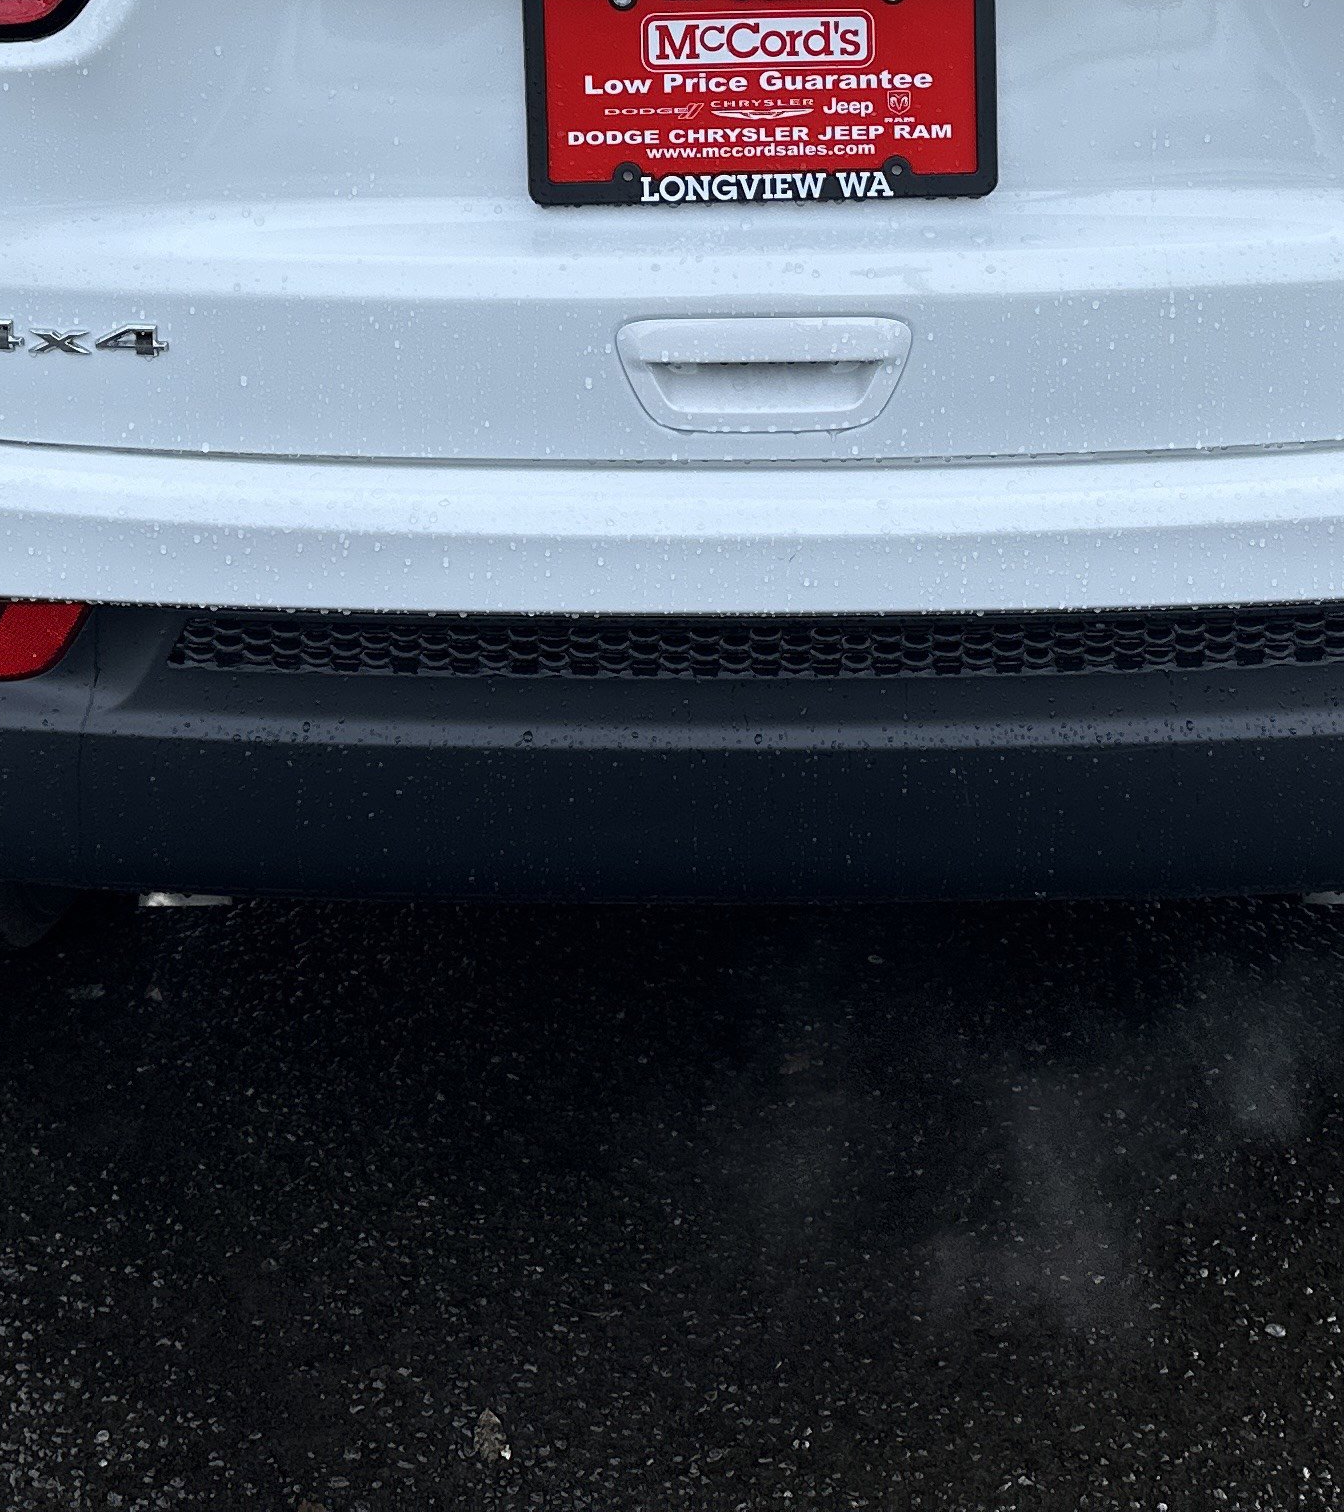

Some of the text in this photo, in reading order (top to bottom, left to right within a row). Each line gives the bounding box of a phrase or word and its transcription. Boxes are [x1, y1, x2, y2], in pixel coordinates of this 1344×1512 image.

[655, 20, 861, 60] McCord's
[584, 69, 933, 94] Low Price Guarantee
[604, 98, 874, 117] DODGE CHRYSLER Jeep
[568, 124, 952, 145] DODGE CHRYSLER JEEP RAM
[646, 143, 876, 158] www.mccordsales.com
[641, 171, 894, 202] LONGVIEW WA
